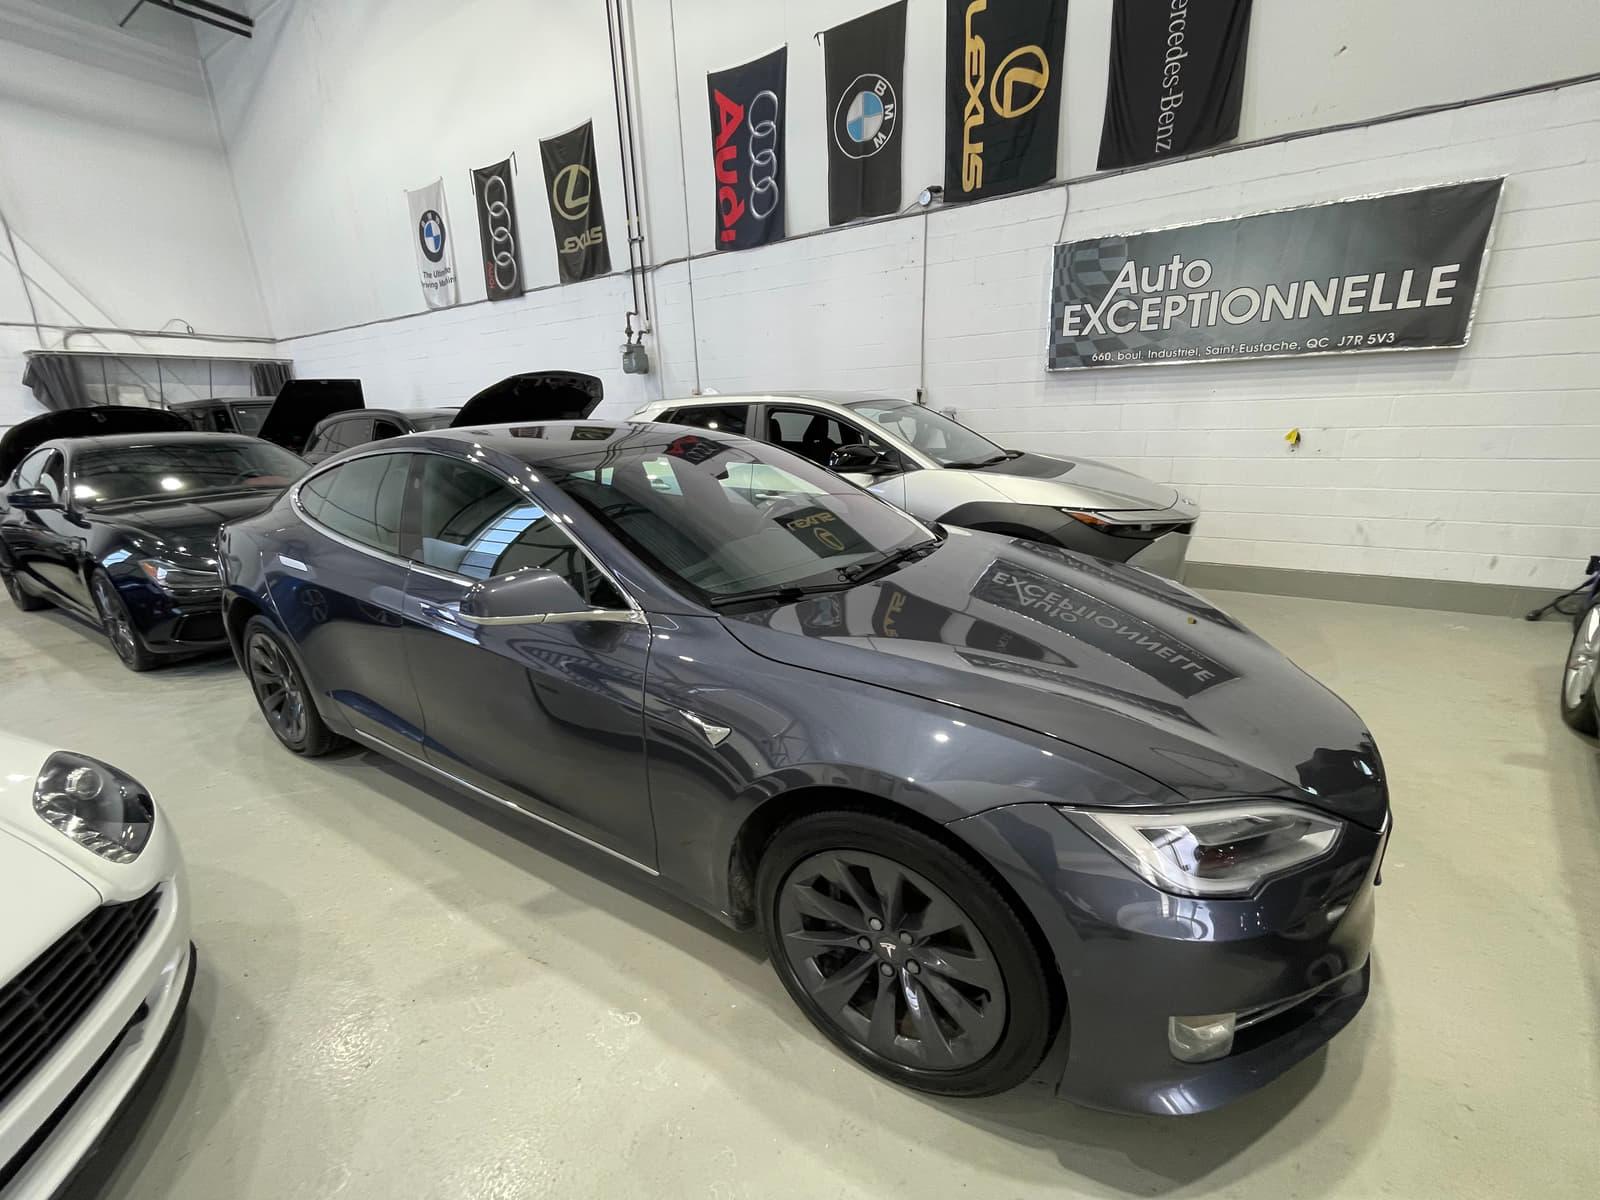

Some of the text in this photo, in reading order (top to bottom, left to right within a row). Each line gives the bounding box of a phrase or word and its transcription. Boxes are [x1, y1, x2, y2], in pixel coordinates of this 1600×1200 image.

[962, 0, 987, 192] LEXUS
[1156, 0, 1188, 153] ercedes-Benz
[874, 79, 895, 149] BMW
[560, 225, 603, 254] EXUS
[420, 280, 439, 290] riving
[1062, 264, 1461, 338] EXCEPTIONNELLE
[1108, 254, 1212, 296] Auto
[1306, 337, 1330, 349] QC
[1337, 334, 1364, 347] J7R
[1367, 332, 1396, 345] 5V3
